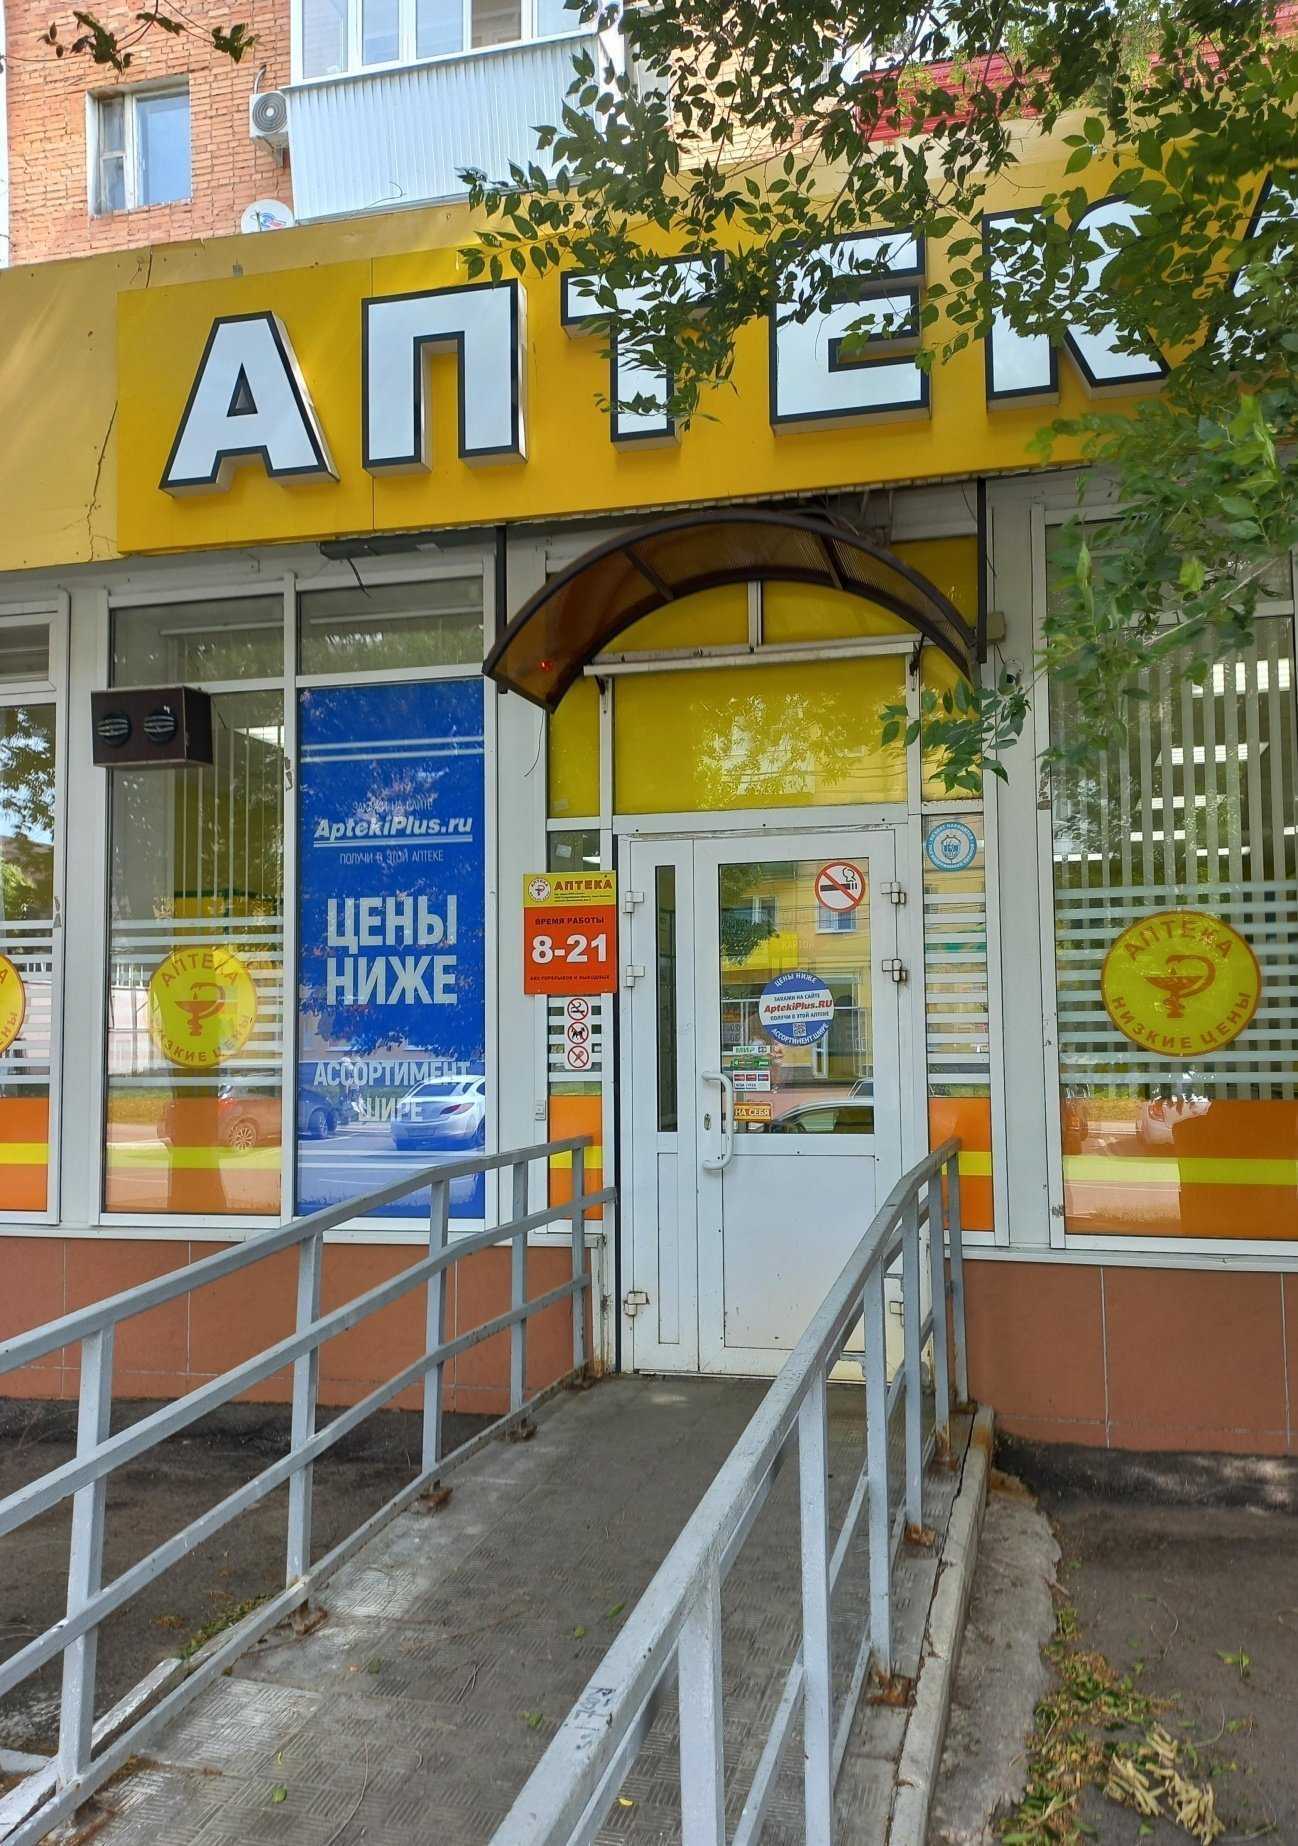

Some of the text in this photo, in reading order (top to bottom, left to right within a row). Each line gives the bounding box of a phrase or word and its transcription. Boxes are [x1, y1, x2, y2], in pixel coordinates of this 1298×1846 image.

[314, 815, 473, 841] AptekiPlus.ru
[412, 848, 444, 864] АПТЕКЕ
[553, 879, 613, 891] АПТЕКА
[326, 894, 458, 954] ЦЕНЫ
[535, 916, 605, 926] ВРЕМЯ РАБОТЫ
[531, 933, 608, 964] 8-21
[1123, 919, 1234, 961] АПТЕКА
[326, 955, 458, 1005] НИЖЕ
[774, 972, 817, 987] ЦЕНЫ НИЖЕ
[764, 999, 834, 1014] AptekiPlus.RU
[1112, 992, 1251, 1049] НИЗКИЕ ЦЕНЫ
[771, 1028, 812, 1045] АССОРТИМЕНТ
[313, 1060, 471, 1087] АССОРТИМЕНТ
[358, 1097, 424, 1122] ШИРЕ
